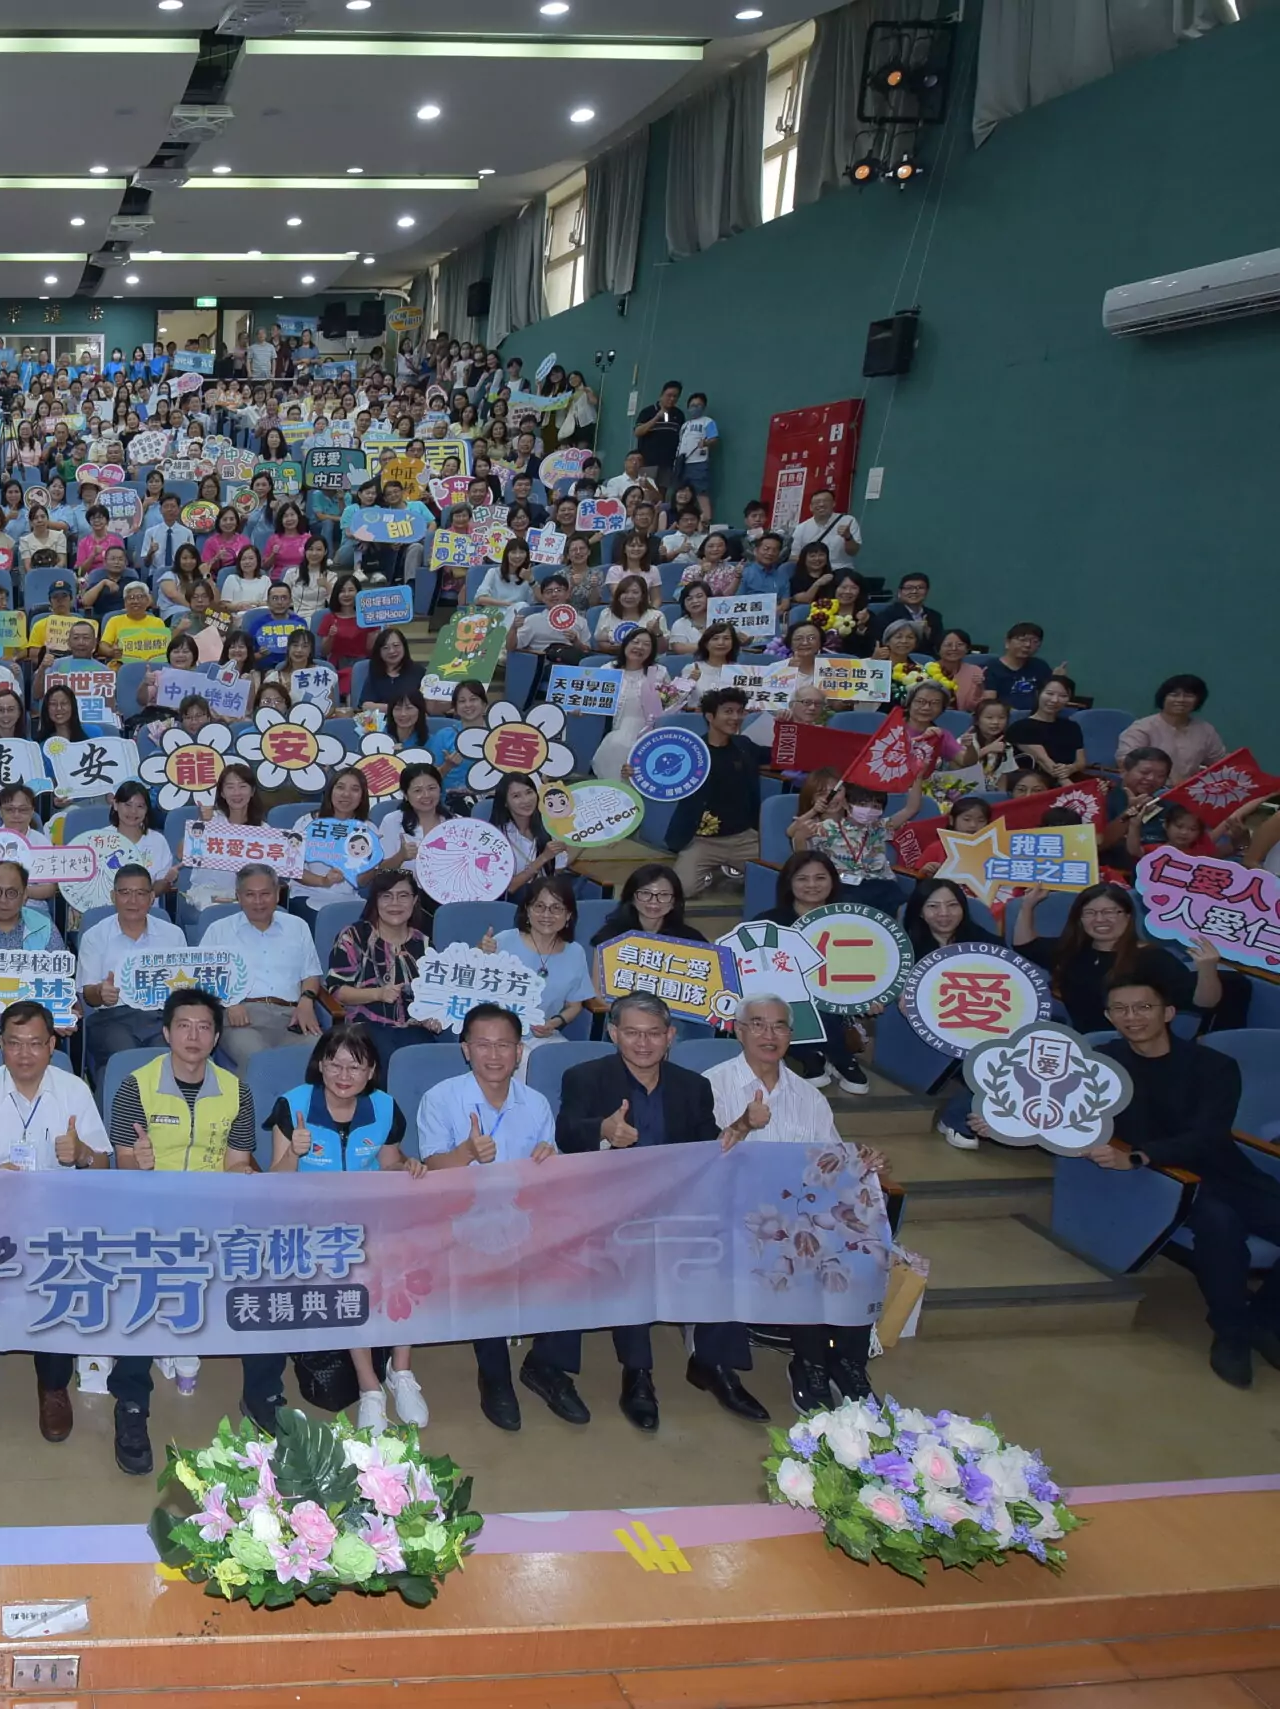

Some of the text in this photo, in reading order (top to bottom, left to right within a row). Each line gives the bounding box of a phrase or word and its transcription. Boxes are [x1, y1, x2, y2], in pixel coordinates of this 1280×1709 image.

[224, 448, 255, 464] 中正
[312, 452, 342, 466] 我愛
[314, 472, 343, 487] 中正
[390, 467, 417, 480] 中正
[472, 506, 510, 523] 中正
[592, 516, 624, 531] 五常
[733, 601, 763, 612] 改善
[294, 671, 332, 689] 吉林
[554, 677, 616, 693] 天母學區
[733, 675, 763, 687] 促進
[819, 667, 884, 679] 結合地方
[821, 680, 869, 692] 與中央
[552, 693, 615, 709] 安全聯盟
[269, 730, 312, 764] 安
[495, 730, 540, 770] 香
[776, 724, 798, 764] RIXIN
[70, 743, 118, 786] 安
[175, 752, 217, 785] 龍
[311, 822, 349, 841] 古亭
[571, 805, 641, 842] good team
[206, 836, 285, 861] 我愛古亭
[1010, 834, 1064, 857] 我是
[984, 858, 1090, 885] 仁愛之星
[1150, 854, 1271, 912] 仁愛人
[835, 904, 871, 916] LOVE
[1158, 897, 1280, 950] 人愛仁
[141, 951, 229, 967] 我們都是團隊的
[616, 944, 711, 981] 卓越仁愛
[816, 931, 876, 987] 仁
[970, 944, 1008, 958] LOVE
[425, 960, 532, 997] 杏壇芬芳
[612, 968, 708, 1005] 優質團隊
[938, 971, 1011, 1034] 愛
[911, 1013, 944, 1050] HAPPY
[1036, 1043, 1061, 1075] 仁愛
[219, 1225, 364, 1280] 育桃李
[28, 1229, 212, 1332] 芬芳
[232, 1289, 364, 1324] 表揚典禮
